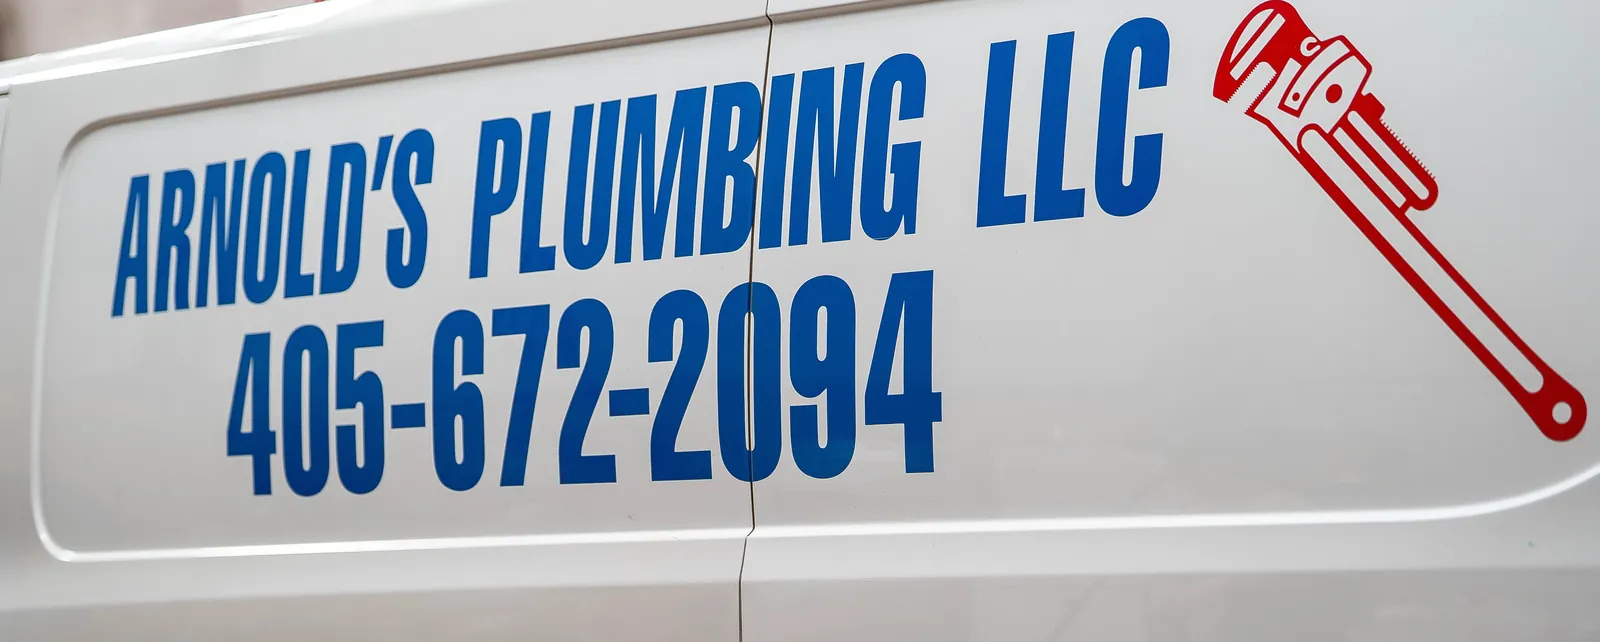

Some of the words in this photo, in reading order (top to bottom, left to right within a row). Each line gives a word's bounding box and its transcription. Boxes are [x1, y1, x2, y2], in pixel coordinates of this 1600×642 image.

[111, 128, 435, 318] ARNOLD'S
[468, 52, 927, 279] PLUMBING
[975, 16, 1171, 228] LLC
[226, 269, 943, 497] 405-672-2094
